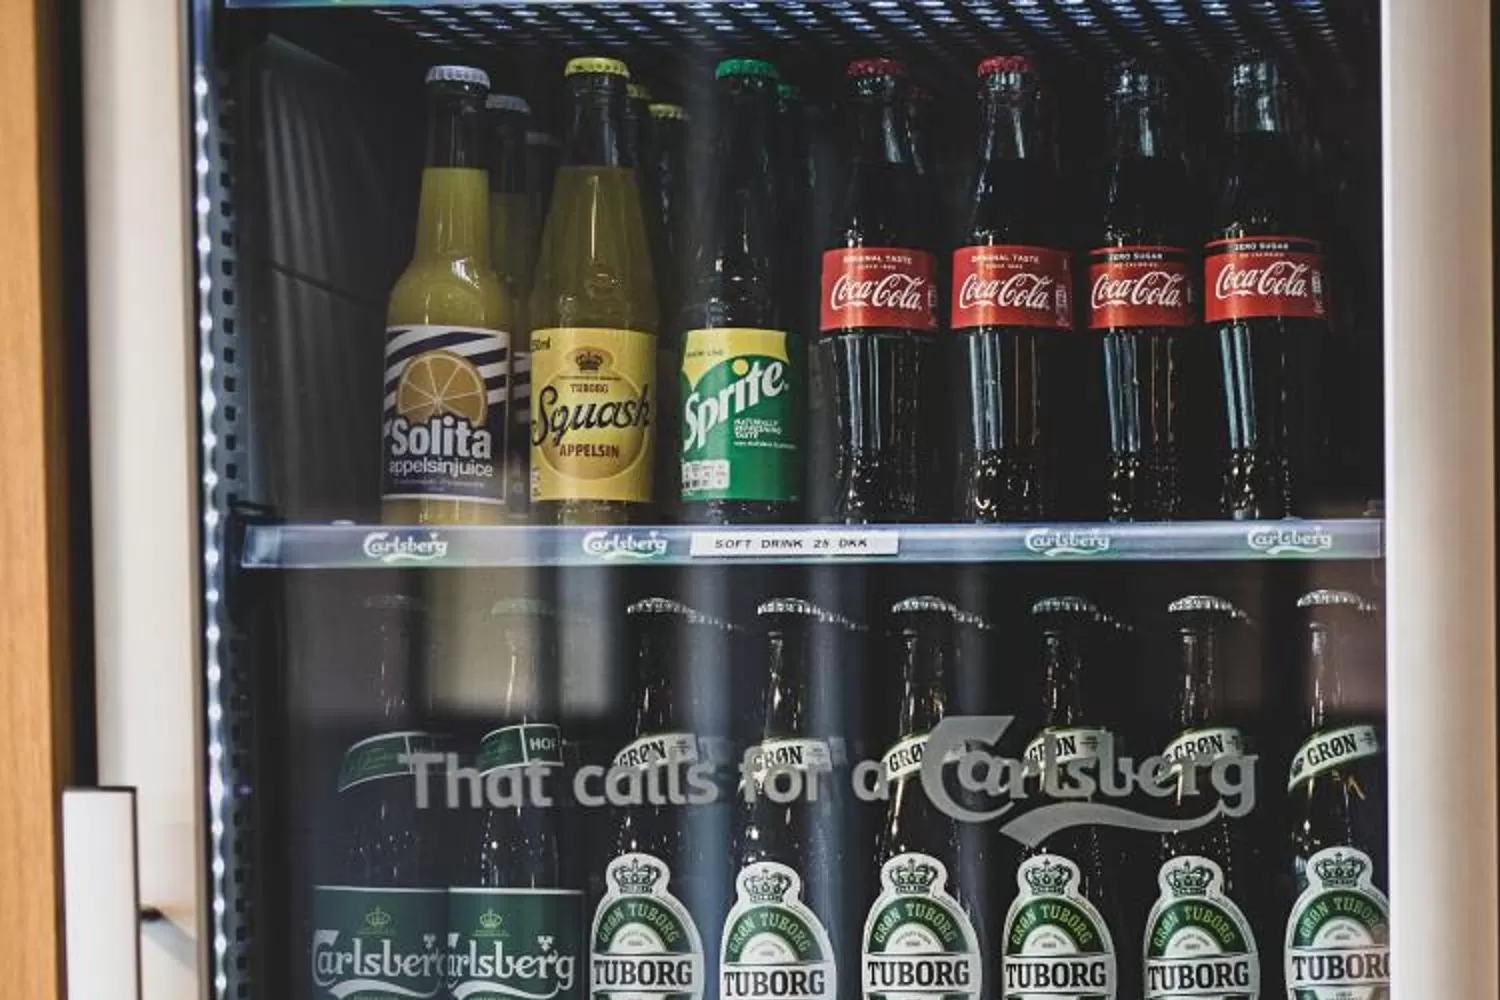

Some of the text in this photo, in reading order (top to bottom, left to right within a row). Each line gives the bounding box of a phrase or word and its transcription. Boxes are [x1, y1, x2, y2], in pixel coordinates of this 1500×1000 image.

[831, 273, 922, 310] Coca-Cola
[959, 273, 1051, 309] Coca-Cola
[1091, 271, 1183, 309] Coca-Cola
[1215, 261, 1308, 299] Coca-Cola
[532, 384, 650, 446] Squash
[683, 359, 785, 452] Sprite
[559, 443, 620, 459] APPELSIN
[389, 456, 493, 478] appelsinjuice
[363, 530, 448, 560] Carlsberg
[582, 530, 667, 559] Carlsberg
[714, 538, 868, 549] SOFT DRINK 25 DKK
[1024, 527, 1110, 556] Carlsberg
[1247, 525, 1333, 554] Carlsberg
[889, 740, 927, 772] GRØ
[1308, 733, 1357, 767] GRØN
[410, 715, 1258, 845] That calls for a Carlsberg
[593, 959, 693, 986] TUBORG
[724, 969, 825, 997] TUBORG
[868, 960, 970, 986] TUBORG
[1005, 962, 1106, 988] TUBORG
[1147, 961, 1249, 991] TUBORG
